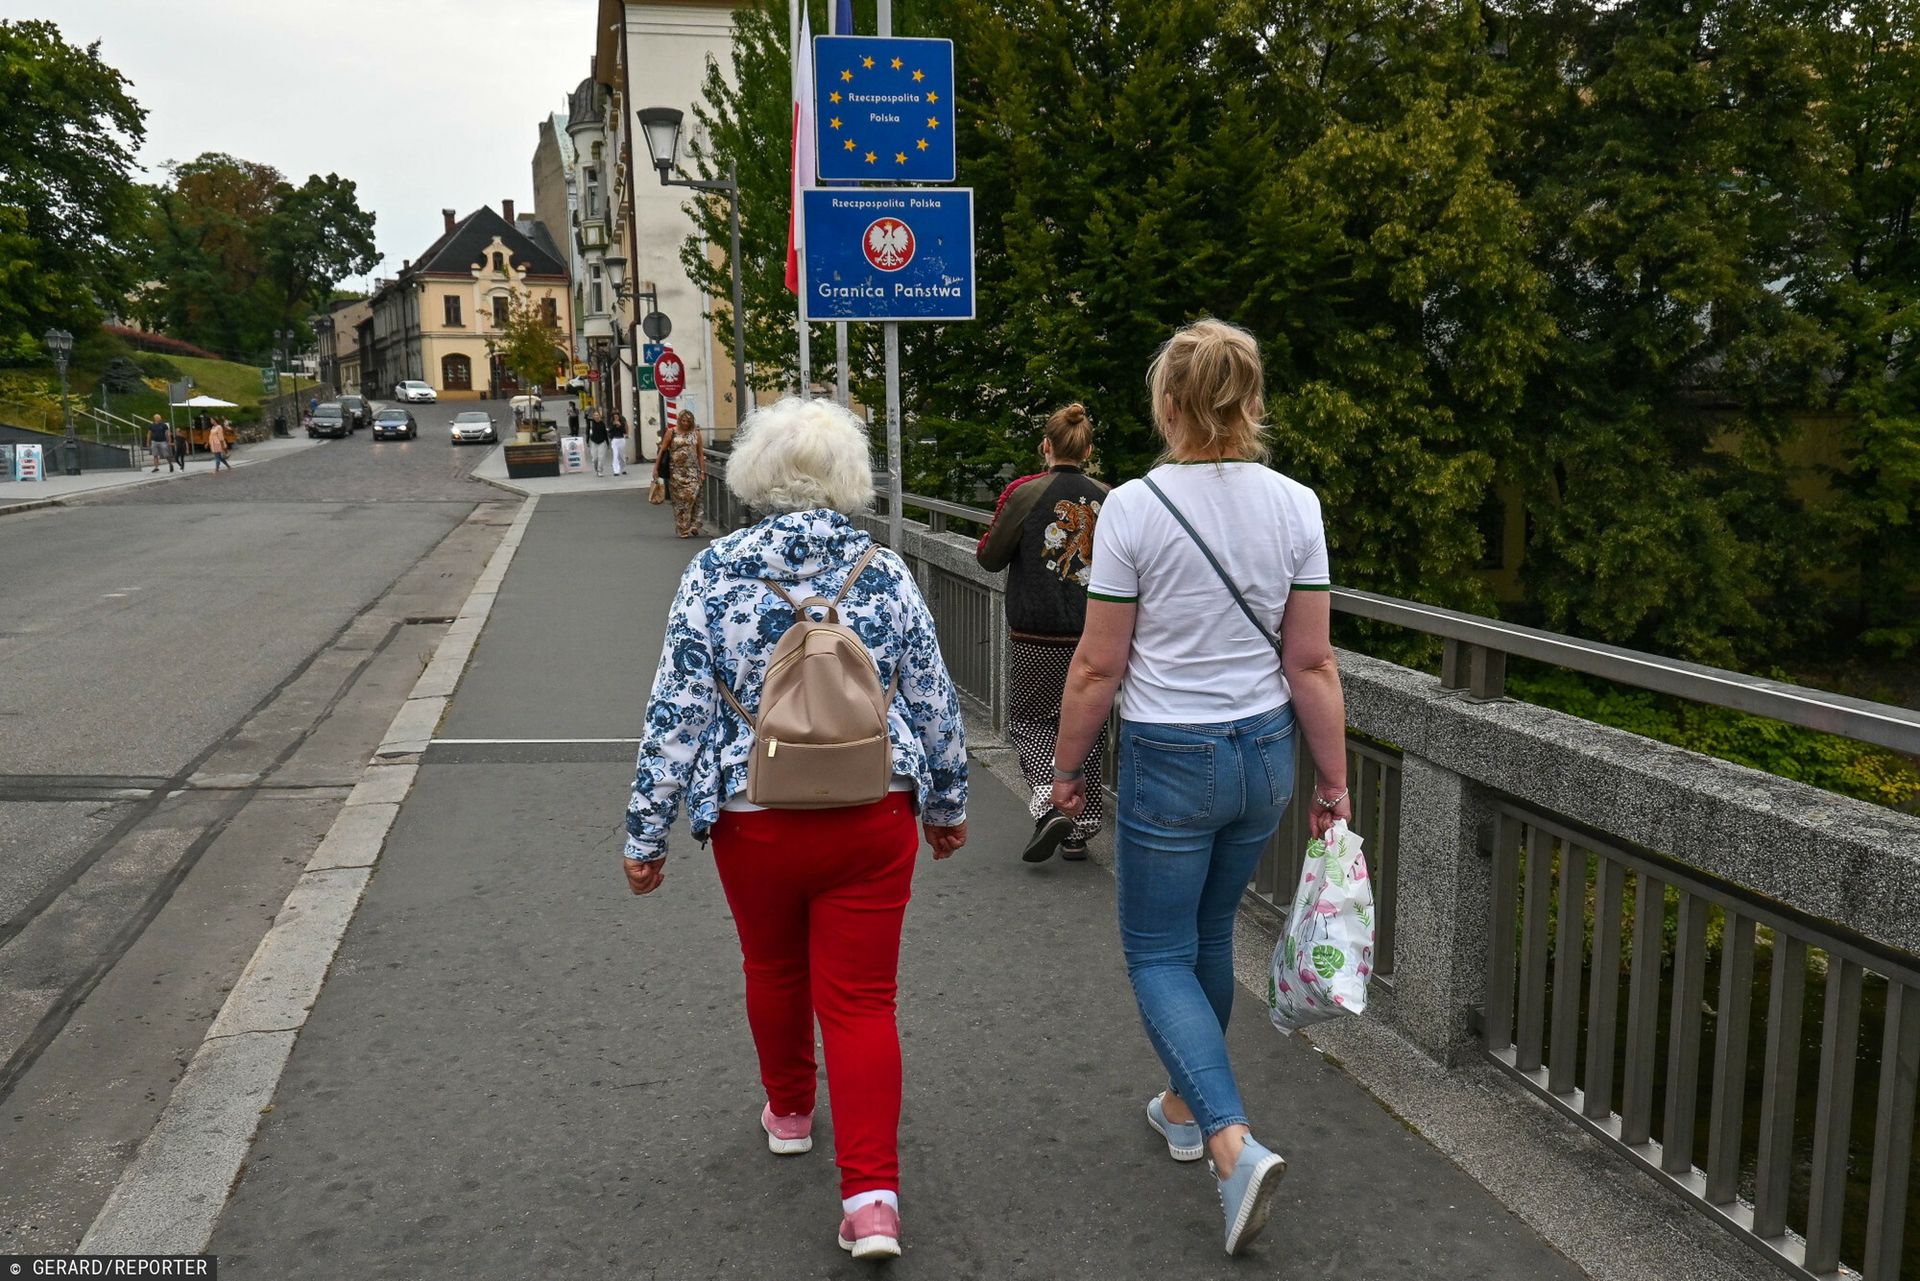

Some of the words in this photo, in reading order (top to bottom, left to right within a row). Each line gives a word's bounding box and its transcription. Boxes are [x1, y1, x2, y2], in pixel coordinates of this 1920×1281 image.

[848, 92, 920, 103] Rzeczpospolita
[870, 113, 900, 122] Polska
[832, 198, 905, 209] Rzeczpospolita
[910, 198, 941, 208] Polska
[818, 283, 884, 297] Granica
[894, 282, 961, 297] Państwa
